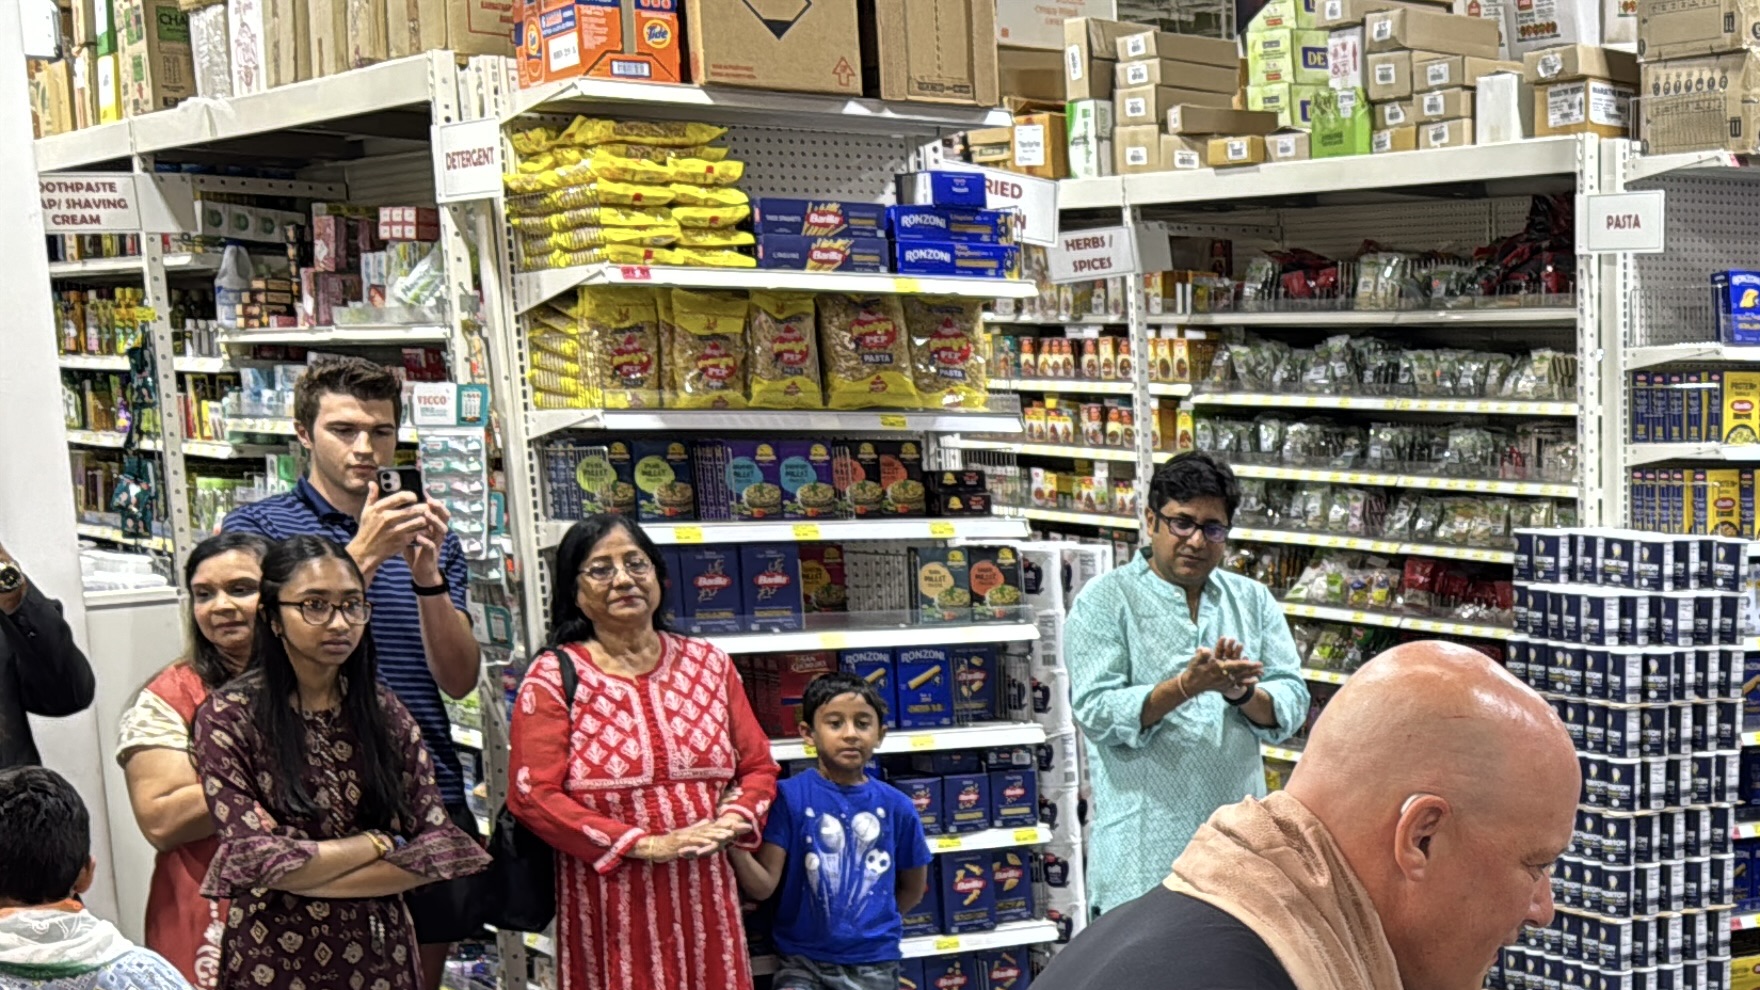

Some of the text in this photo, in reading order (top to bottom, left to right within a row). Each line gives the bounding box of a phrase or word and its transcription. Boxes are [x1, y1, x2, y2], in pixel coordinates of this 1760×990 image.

[647, 25, 669, 40] Tide
[445, 146, 494, 171] DETERGENT
[65, 197, 128, 210] SHAVING
[51, 213, 101, 226] CREAM
[809, 213, 841, 225] Barilla
[900, 214, 946, 230] RONZONI
[1606, 214, 1641, 230] PASTA
[1064, 236, 1106, 252] HERBS
[812, 251, 843, 261] Barilla
[905, 248, 951, 263] RONZONI
[1072, 256, 1113, 272] SPICES
[863, 354, 891, 364] PASTA
[939, 369, 963, 379] PASTA
[417, 395, 447, 406] VICCO
[698, 576, 728, 587] Barilla
[757, 575, 788, 586] Barilla
[845, 651, 890, 664] RONZONI
[901, 649, 946, 663] RONZONI
